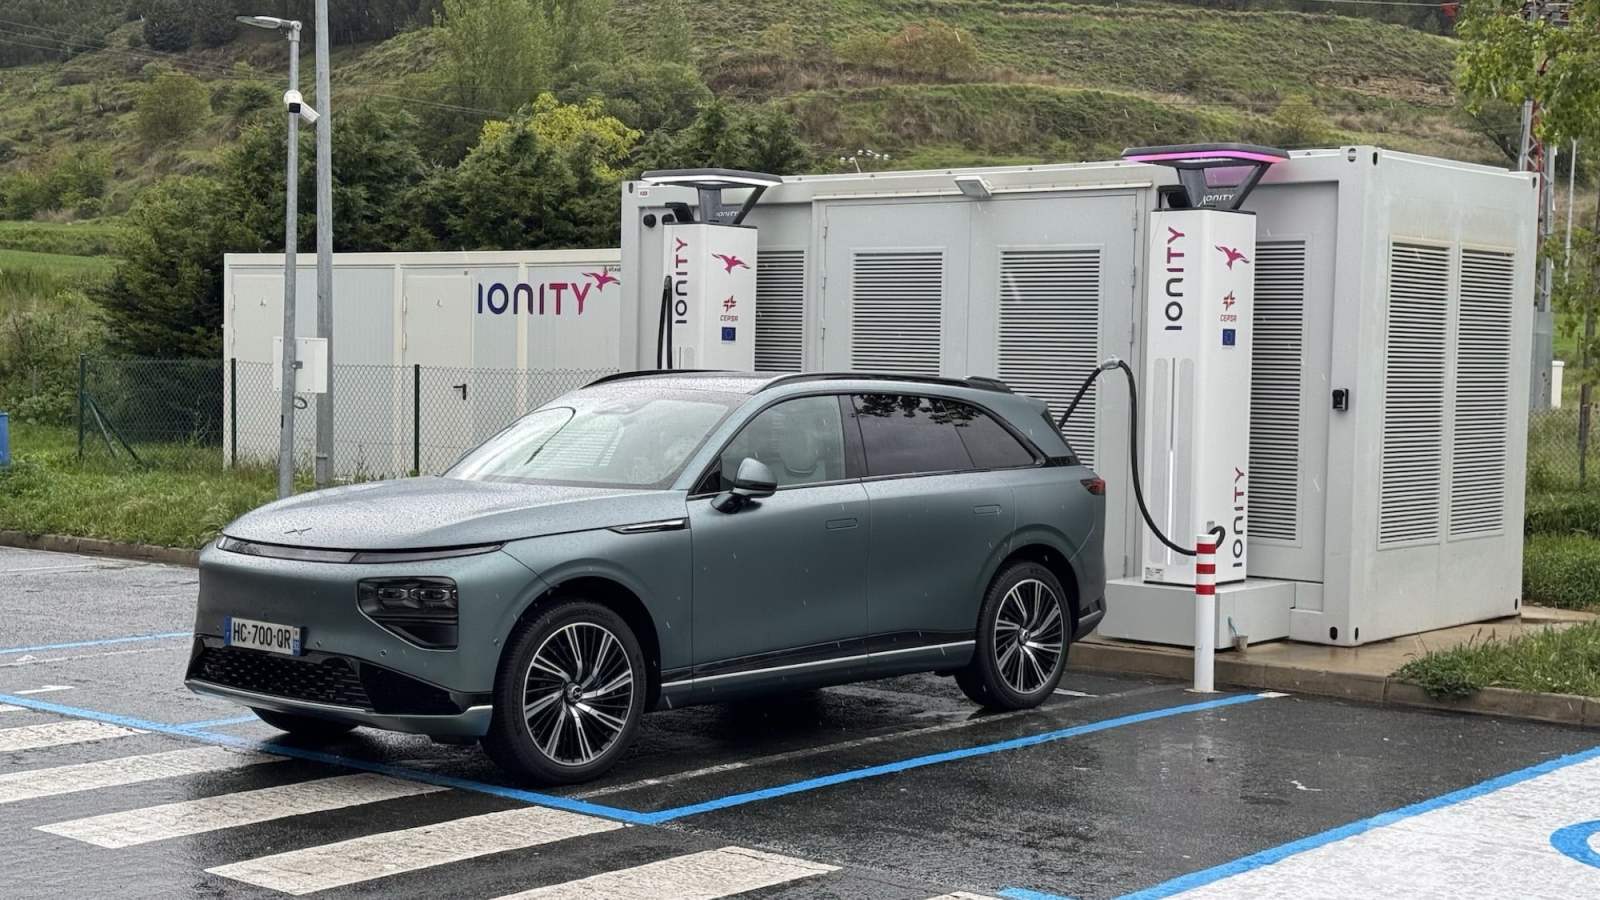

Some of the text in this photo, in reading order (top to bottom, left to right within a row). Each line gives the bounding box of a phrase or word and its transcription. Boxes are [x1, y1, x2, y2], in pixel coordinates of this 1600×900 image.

[478, 283, 591, 315] IONITY
[675, 237, 688, 324] IONITY
[1165, 226, 1185, 330] IONITY
[1233, 467, 1244, 567] IONITY
